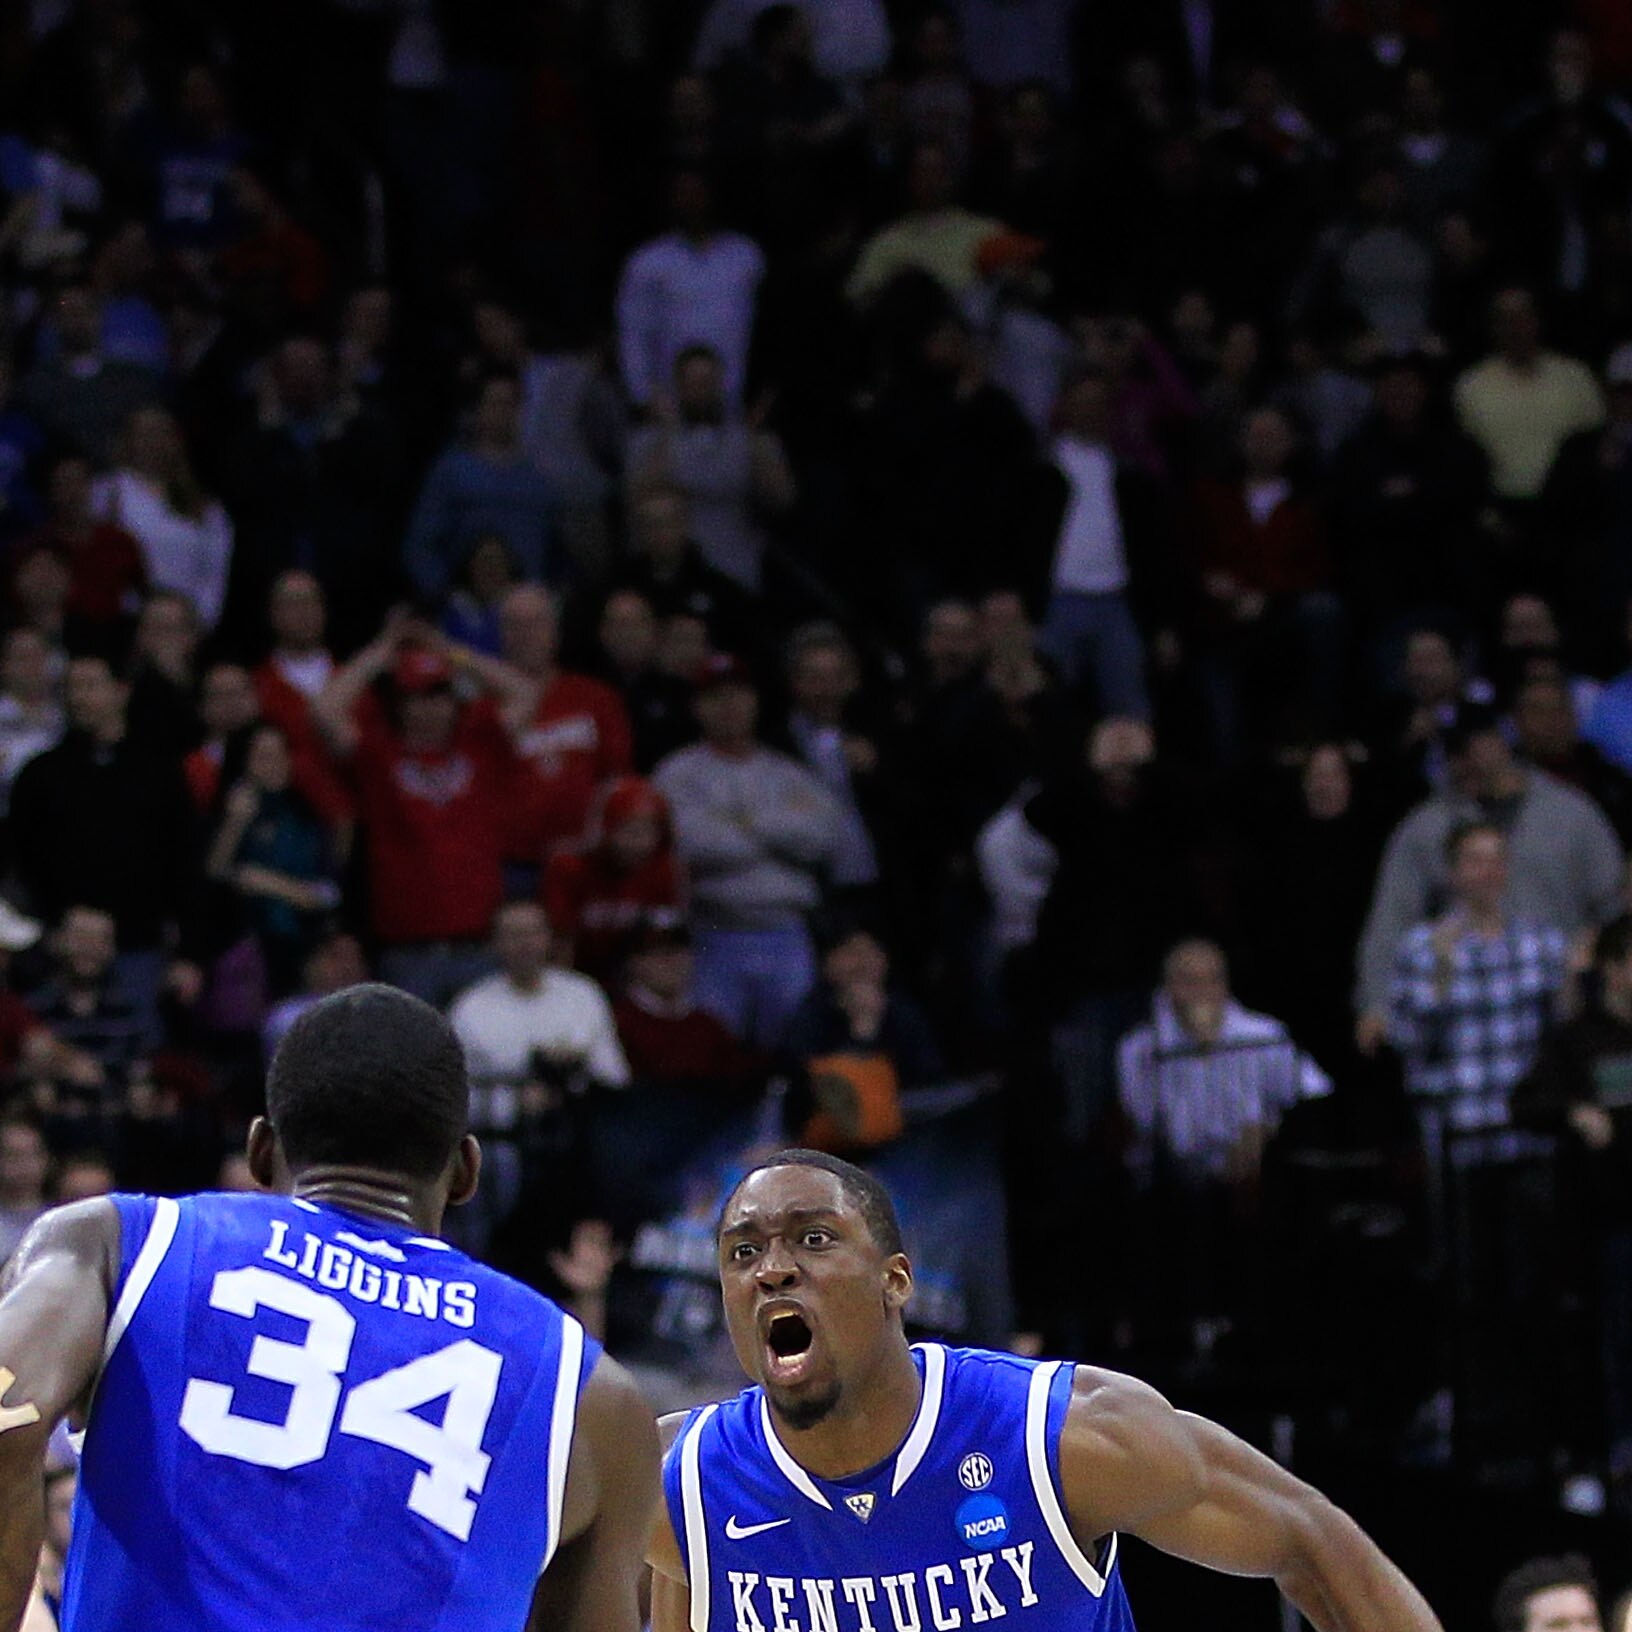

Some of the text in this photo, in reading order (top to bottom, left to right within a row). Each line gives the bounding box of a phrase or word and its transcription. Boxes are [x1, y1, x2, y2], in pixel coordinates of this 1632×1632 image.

[262, 1219, 478, 1329] LIGGINS
[178, 1265, 505, 1543] 34
[960, 1455, 993, 1489] SEC
[963, 1515, 1007, 1540] NCAA
